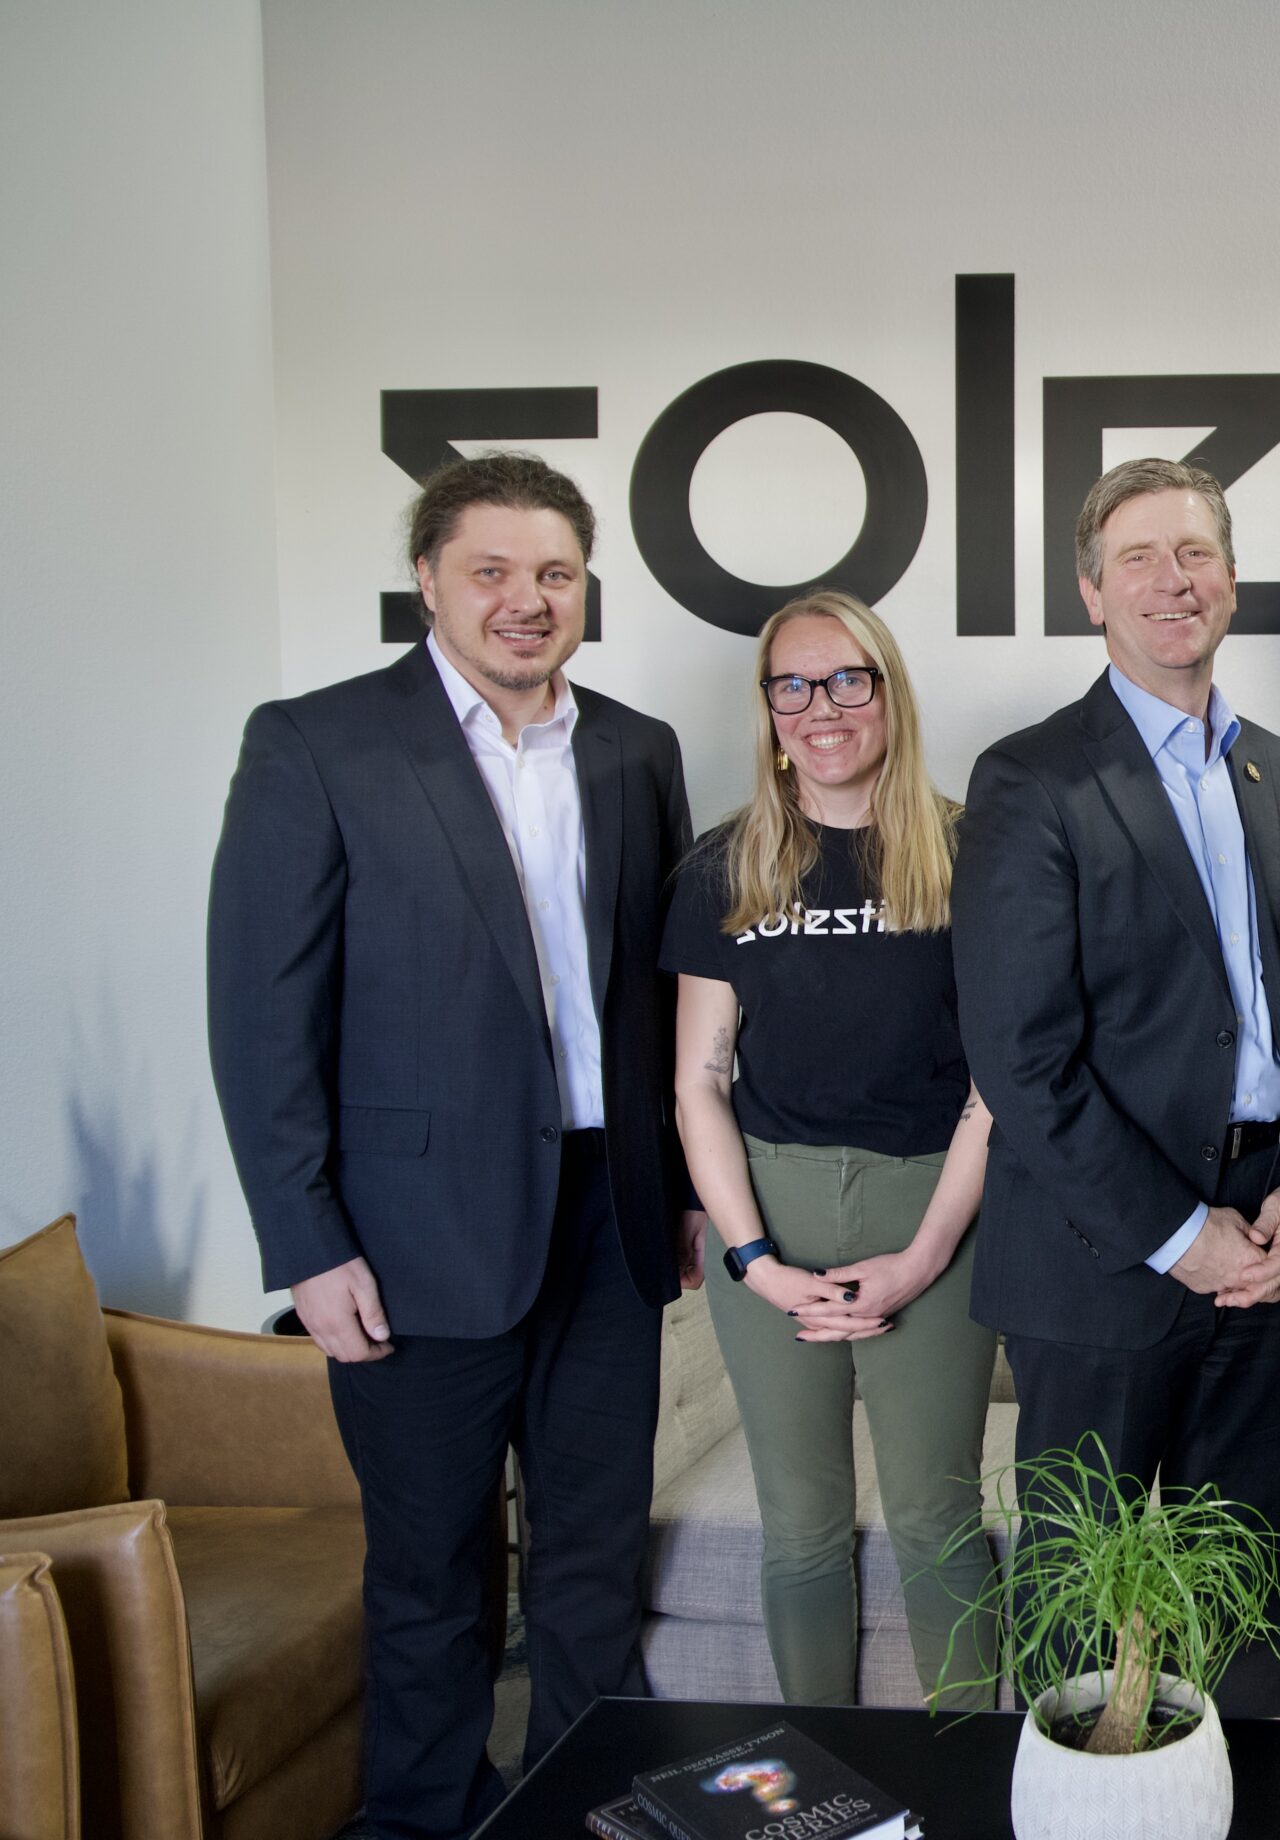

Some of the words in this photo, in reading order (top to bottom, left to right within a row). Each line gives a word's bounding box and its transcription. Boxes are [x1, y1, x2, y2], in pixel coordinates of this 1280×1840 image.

[650, 1769, 682, 1782] NEIL
[744, 1727, 785, 1748] TYSON
[745, 1793, 853, 1840] COSMIC
